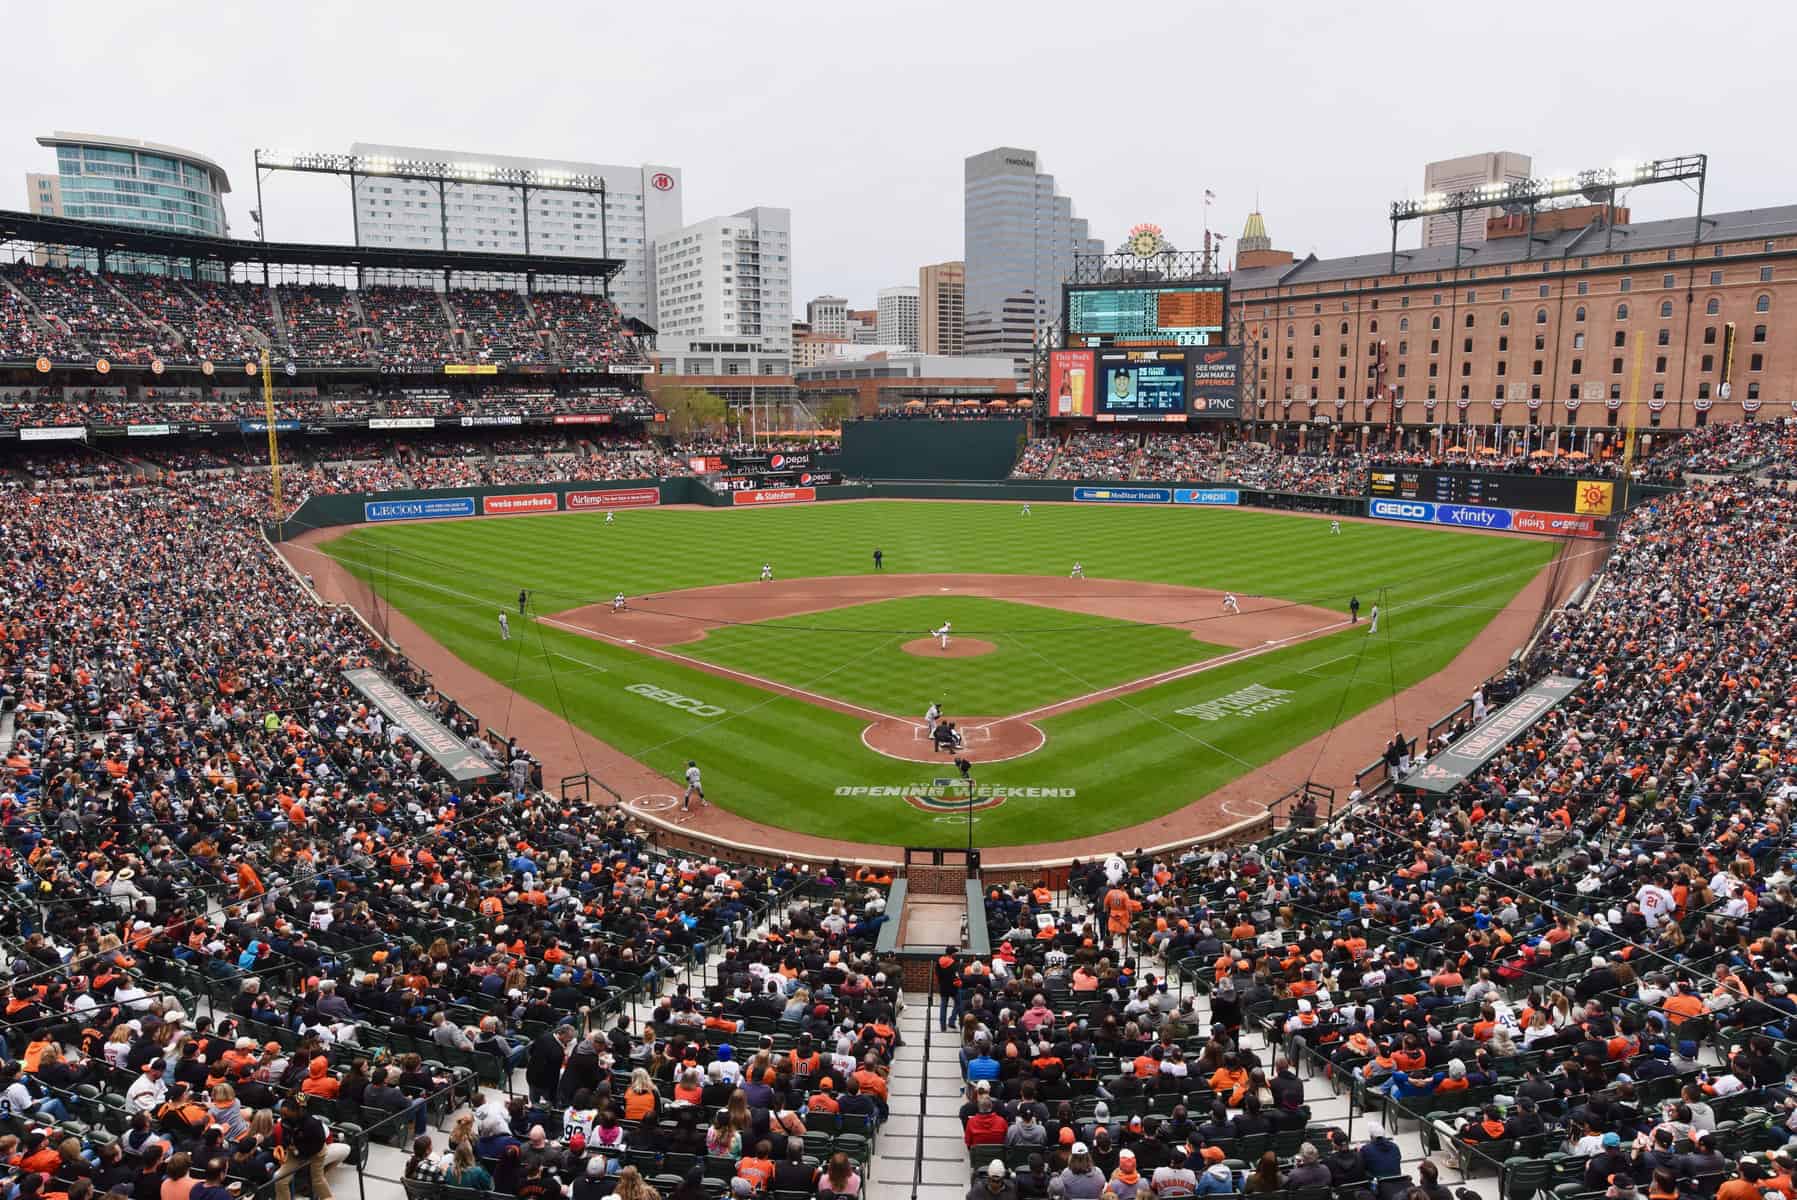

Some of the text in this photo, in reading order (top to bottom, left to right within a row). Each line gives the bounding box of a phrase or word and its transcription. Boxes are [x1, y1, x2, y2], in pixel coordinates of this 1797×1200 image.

[1190, 335, 1196, 345] 2
[1208, 398, 1235, 409] PNC
[785, 455, 809, 465] pepsi
[812, 473, 832, 481] pepsi
[514, 498, 552, 506] markets
[1201, 493, 1226, 502] pepsi
[1376, 502, 1425, 517] GEICO
[1451, 507, 1495, 526] xfinity
[624, 683, 727, 717] GEICO
[834, 784, 1077, 798] OPENING WEEKEND
